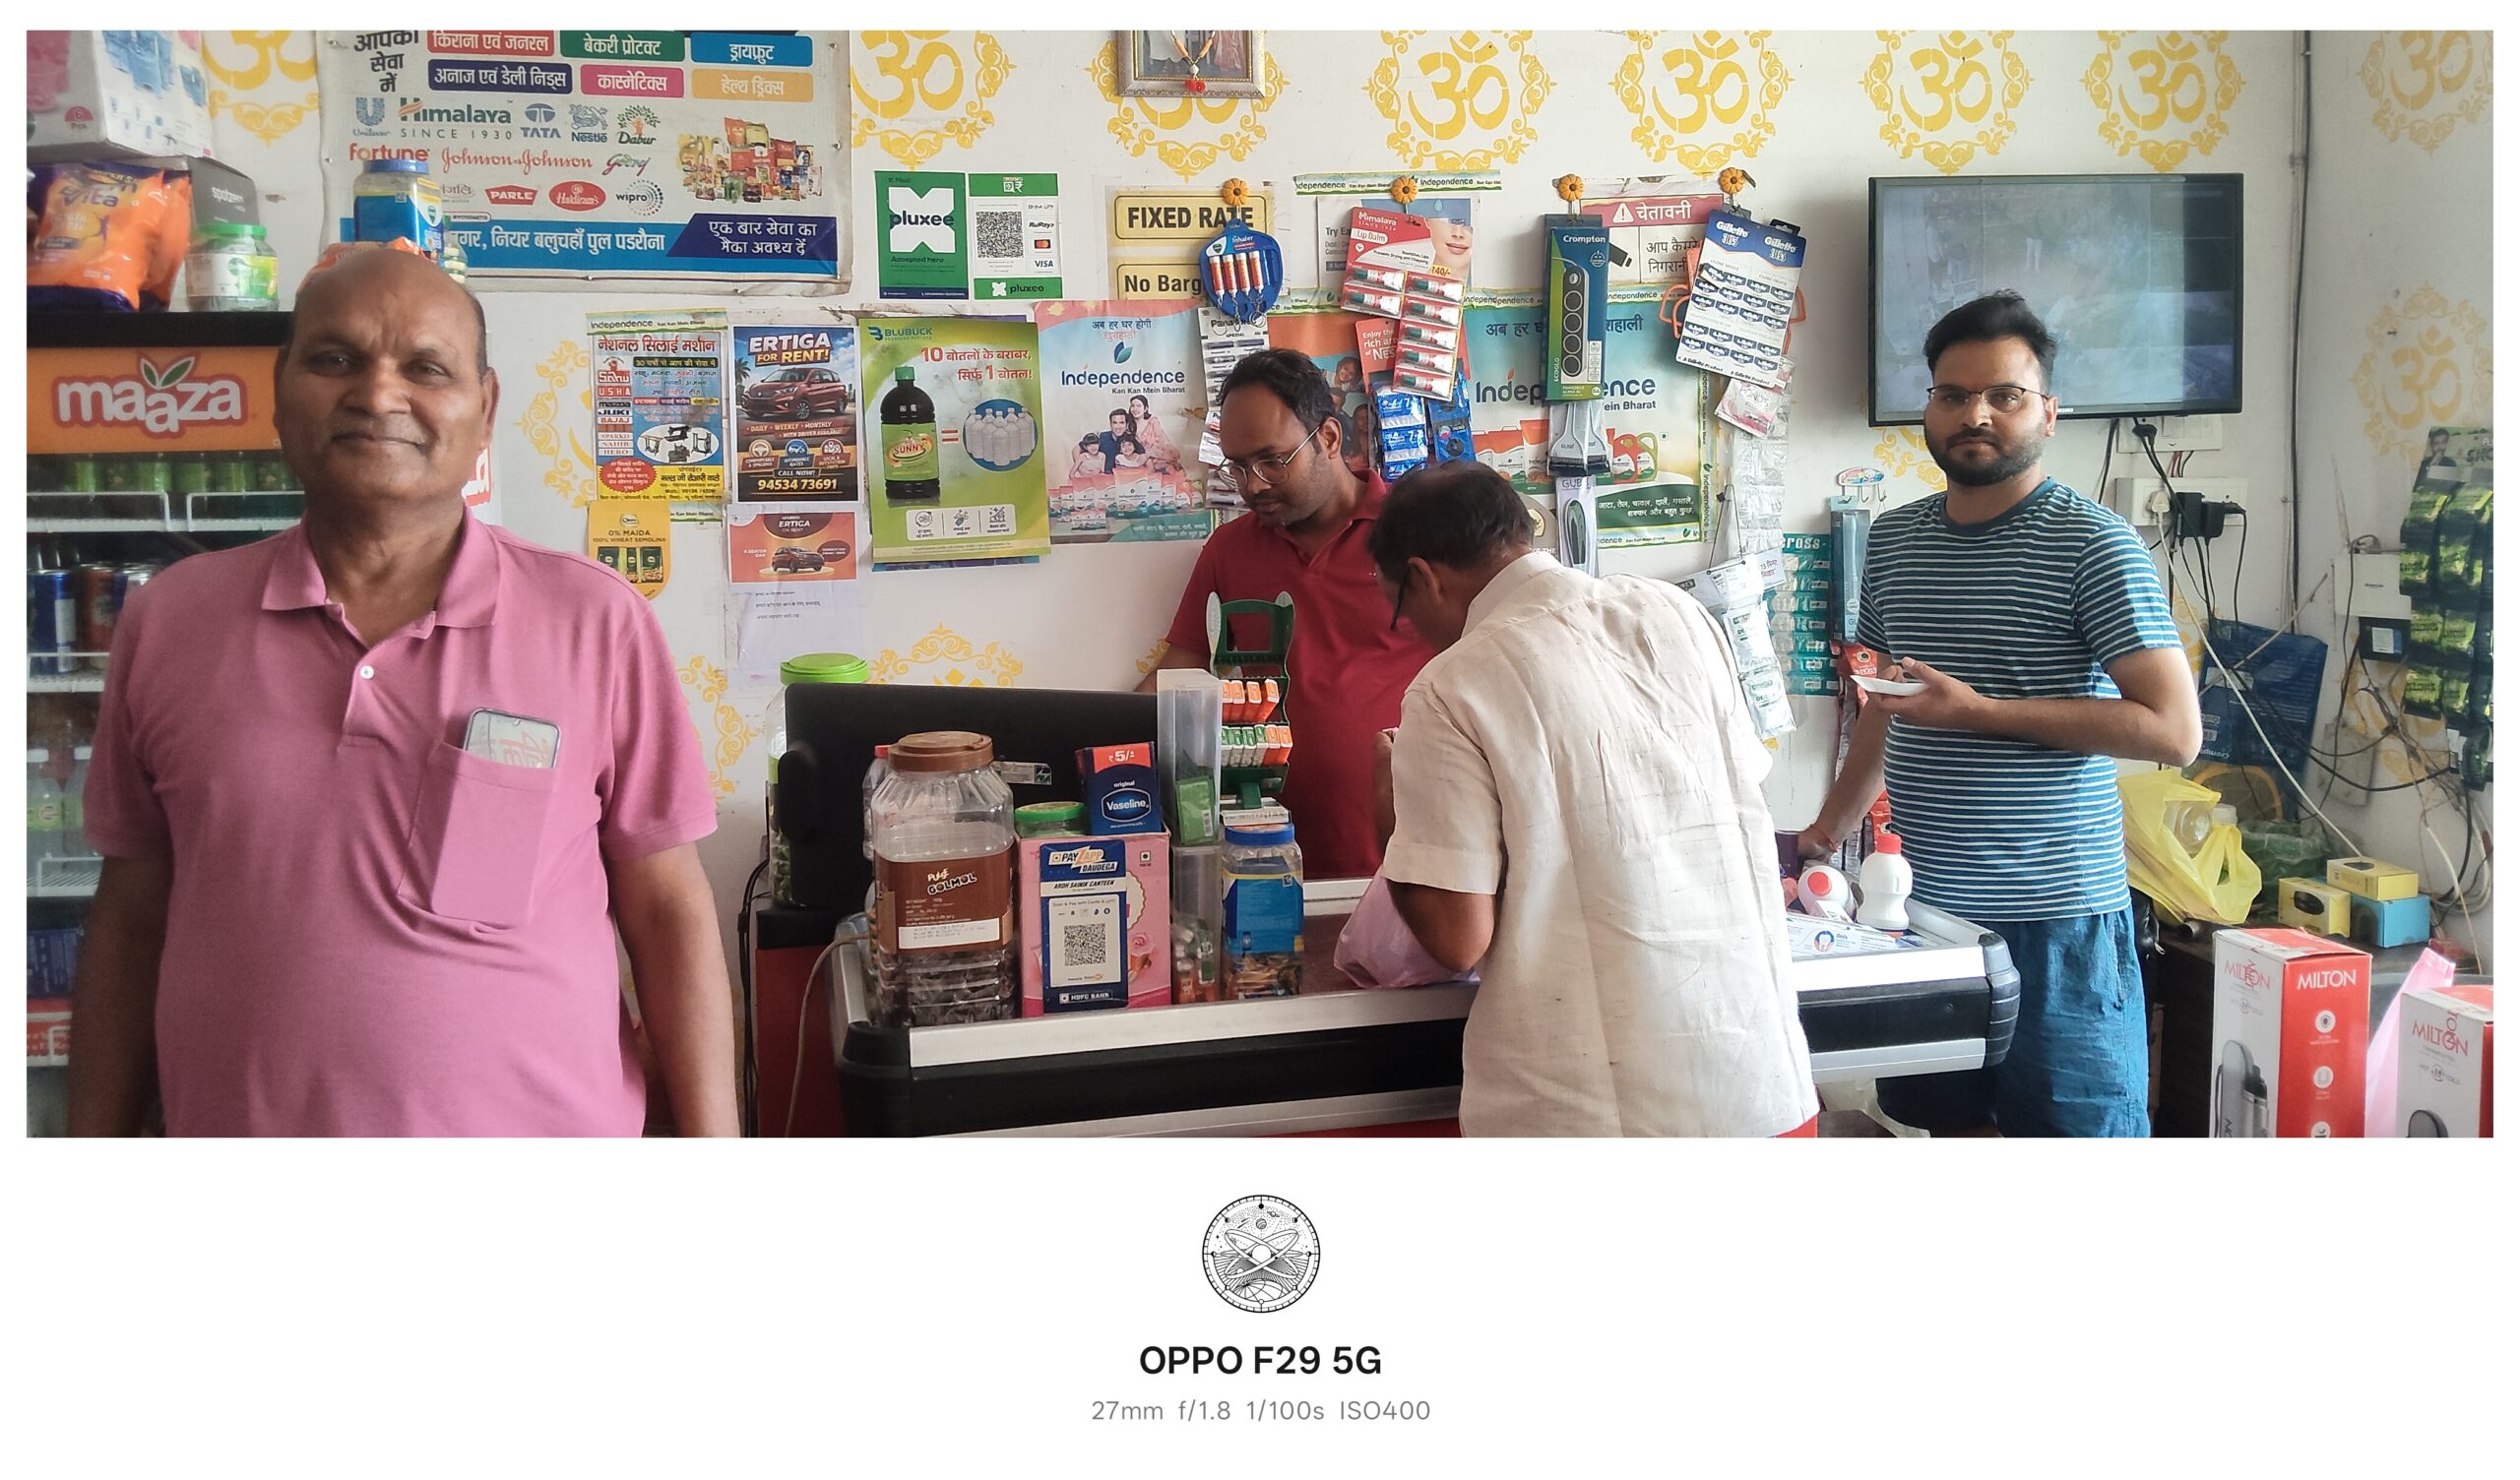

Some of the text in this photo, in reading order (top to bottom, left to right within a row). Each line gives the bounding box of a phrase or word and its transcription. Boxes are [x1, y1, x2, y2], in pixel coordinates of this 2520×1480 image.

[505, 35, 548, 51] जनरल
[584, 33, 618, 54] बेकरी
[370, 51, 405, 72] सेवा
[379, 72, 398, 92] में
[434, 68, 475, 84] अनाज
[478, 67, 497, 85] एवं
[501, 67, 527, 86] डेली
[399, 97, 512, 123] Himalaya
[401, 129, 512, 140] SINCE 1930
[520, 127, 561, 139] TATA
[617, 131, 657, 145] Dabur
[349, 143, 426, 162] fortune
[490, 190, 534, 201] PARLE
[615, 192, 648, 204] wipro
[1128, 207, 1191, 228] FIXED
[1635, 200, 1692, 220] चेतावनी
[709, 217, 817, 236] एक बार सेवा का
[889, 211, 954, 229] pluxee
[490, 225, 529, 248] नियर
[1325, 227, 1338, 237] Try
[1563, 234, 1606, 244] Crompton
[1646, 242, 1669, 254] आप
[1125, 276, 1150, 292] No
[591, 320, 654, 330] Independence
[885, 327, 932, 337] BLUBUCK
[1092, 320, 1104, 330] अब
[1108, 320, 1118, 330] हर
[1121, 320, 1133, 330] घर
[1485, 322, 1529, 337] अब हर
[598, 335, 639, 352] नेशनल
[643, 335, 679, 353] सिलाई
[749, 332, 832, 352] ERTIGA
[757, 348, 829, 363] FOR RENT!
[921, 346, 944, 362] 10
[945, 348, 980, 361] बोतलों
[982, 348, 994, 360] के
[985, 365, 994, 380] 1
[1061, 370, 1185, 388] Independence
[598, 386, 631, 397] USHA
[58, 379, 242, 433] maaza
[1604, 400, 1656, 411] ein Bharat
[894, 443, 924, 455] SUNNY
[758, 479, 837, 491] 94534 73691
[1106, 798, 1146, 811] Vaseline
[927, 872, 977, 895] GOLMOL
[2298, 969, 2357, 990] MILTON
[2413, 1019, 2468, 1057] MILTON
